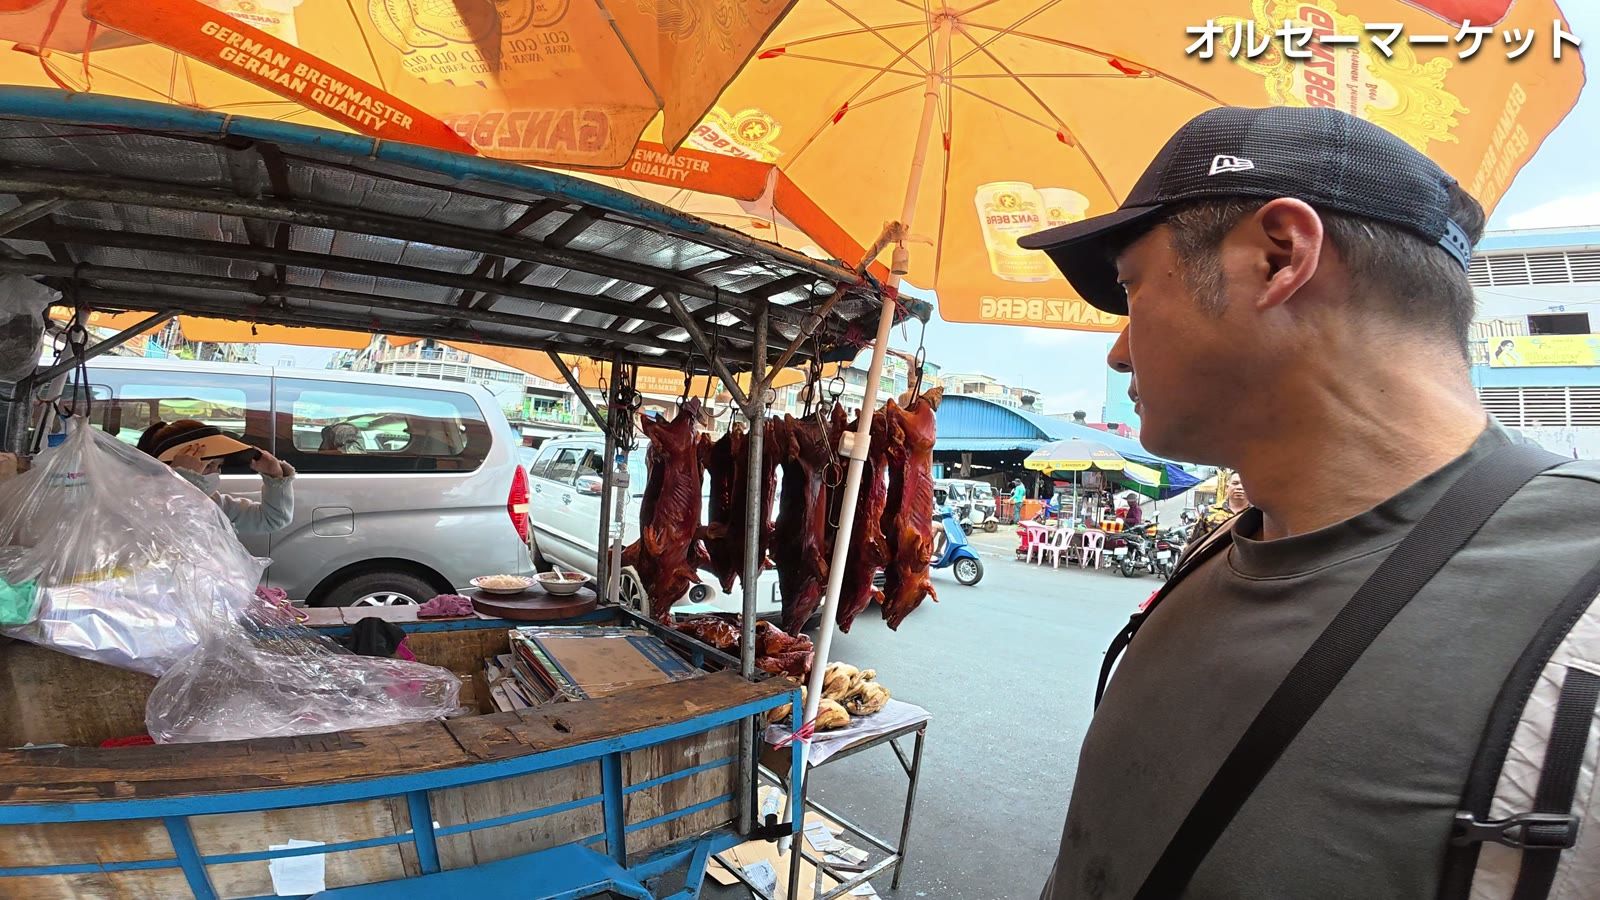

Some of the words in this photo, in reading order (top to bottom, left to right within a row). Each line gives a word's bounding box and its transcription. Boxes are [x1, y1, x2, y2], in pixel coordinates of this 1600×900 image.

[200, 21, 291, 68] GERMAN
[293, 62, 413, 130] BREWMASTER
[219, 46, 307, 94] GERMAN
[311, 87, 387, 132] QUALITY
[631, 161, 690, 182] QUALITY
[632, 149, 710, 173] EWMASTER
